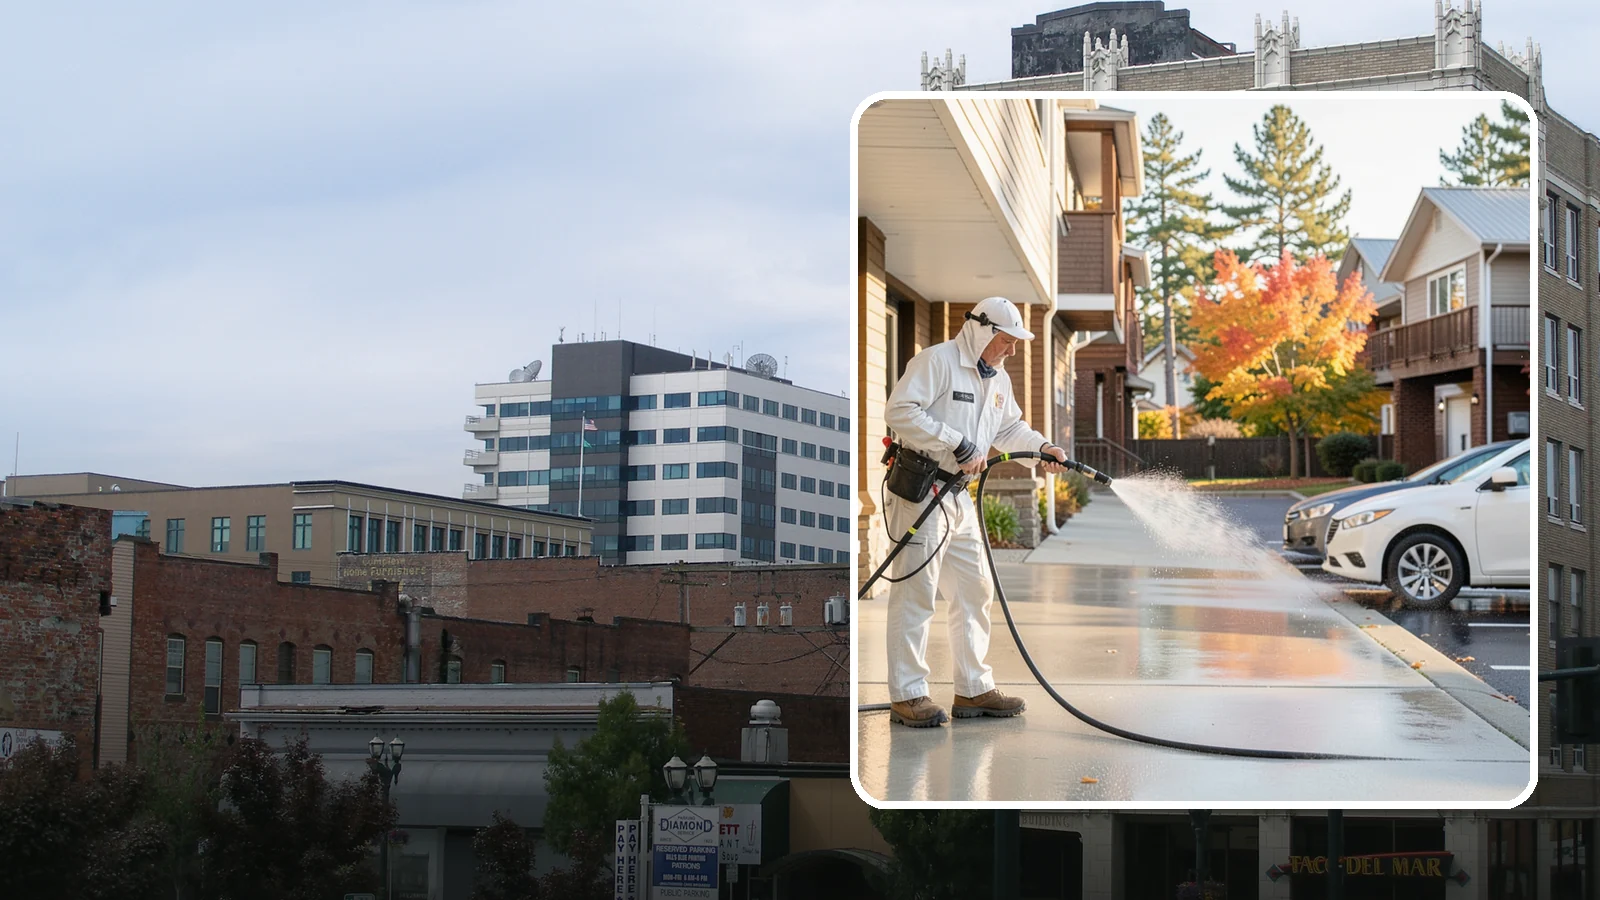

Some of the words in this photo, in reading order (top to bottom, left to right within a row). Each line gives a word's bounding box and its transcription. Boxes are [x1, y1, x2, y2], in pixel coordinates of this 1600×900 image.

[343, 568, 367, 577] Home
[370, 566, 427, 576] Furnishers
[1022, 815, 1070, 828] BUILDING
[617, 825, 625, 852] PAY
[628, 824, 637, 852] PAY
[656, 845, 688, 853] RESERVED
[689, 846, 716, 854] PARKING
[721, 851, 739, 861] Soup
[671, 862, 701, 870] PATRONS
[1289, 855, 1330, 874] TAC
[1345, 856, 1386, 876] DEL
[1392, 857, 1442, 877] MAR
[616, 855, 625, 894] HERE
[627, 855, 636, 893] HERE
[660, 889, 682, 897] PUBLIC
[684, 889, 710, 898] PARKING
